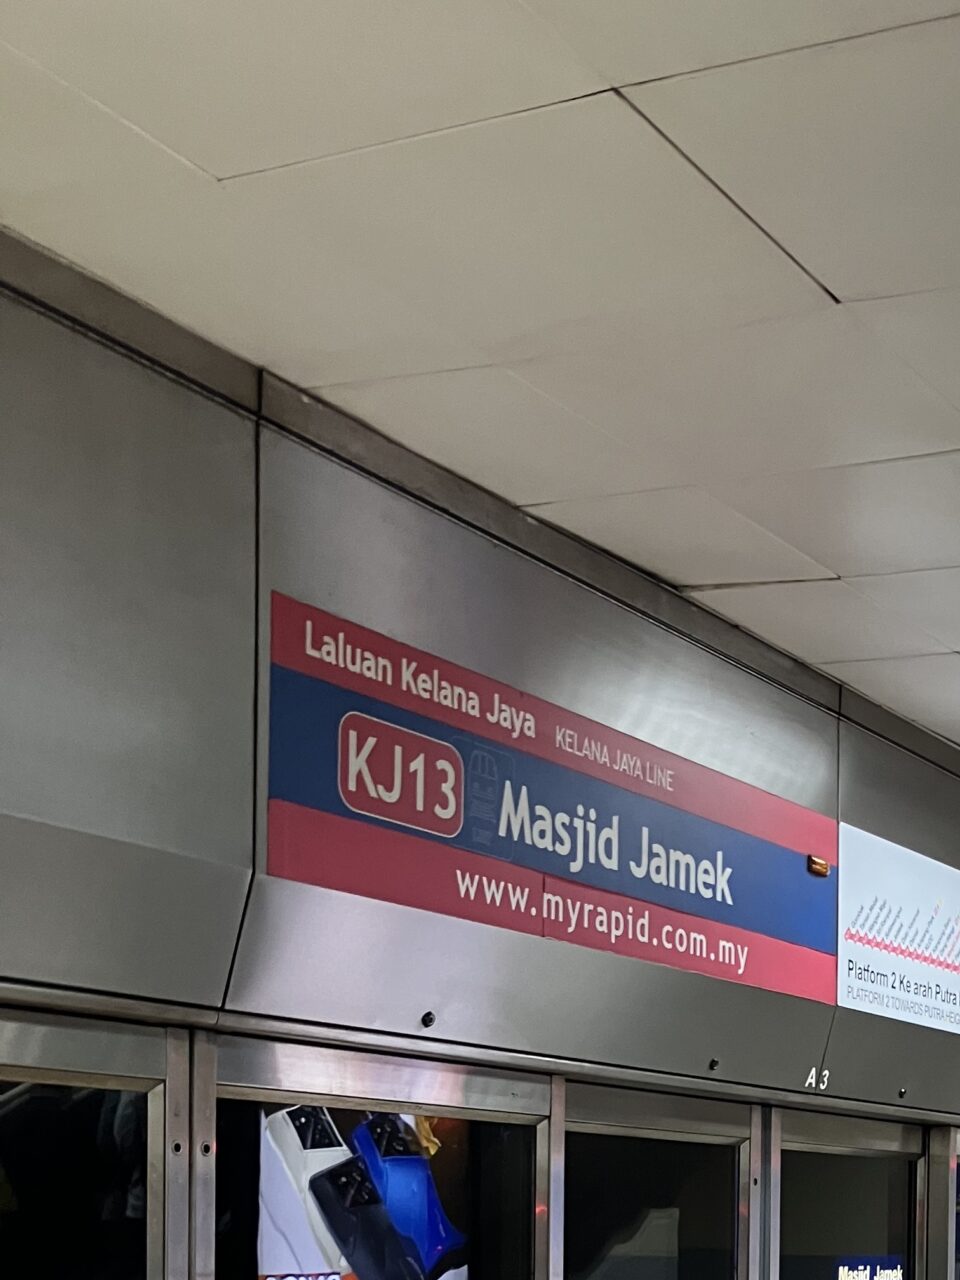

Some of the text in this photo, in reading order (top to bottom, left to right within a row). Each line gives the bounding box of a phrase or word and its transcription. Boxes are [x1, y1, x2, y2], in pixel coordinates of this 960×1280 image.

[304, 620, 536, 739] Laluan Kelana Jaya
[347, 728, 457, 820] KJ13
[555, 724, 675, 791] KELANA JAYA LINE
[498, 780, 734, 906] Masjid Jamek
[455, 868, 749, 975] www.myrapid.com.my
[847, 959, 889, 988] Platform
[891, 971, 897, 990] 2
[899, 973, 911, 993] Ke
[913, 981, 933, 1000] arah
[935, 984, 957, 1006] Putra
[847, 985, 885, 1007] PLATFORM
[885, 995, 890, 1008] 2
[890, 996, 923, 1016] TOWARDS
[924, 1005, 945, 1021] PUTRA
